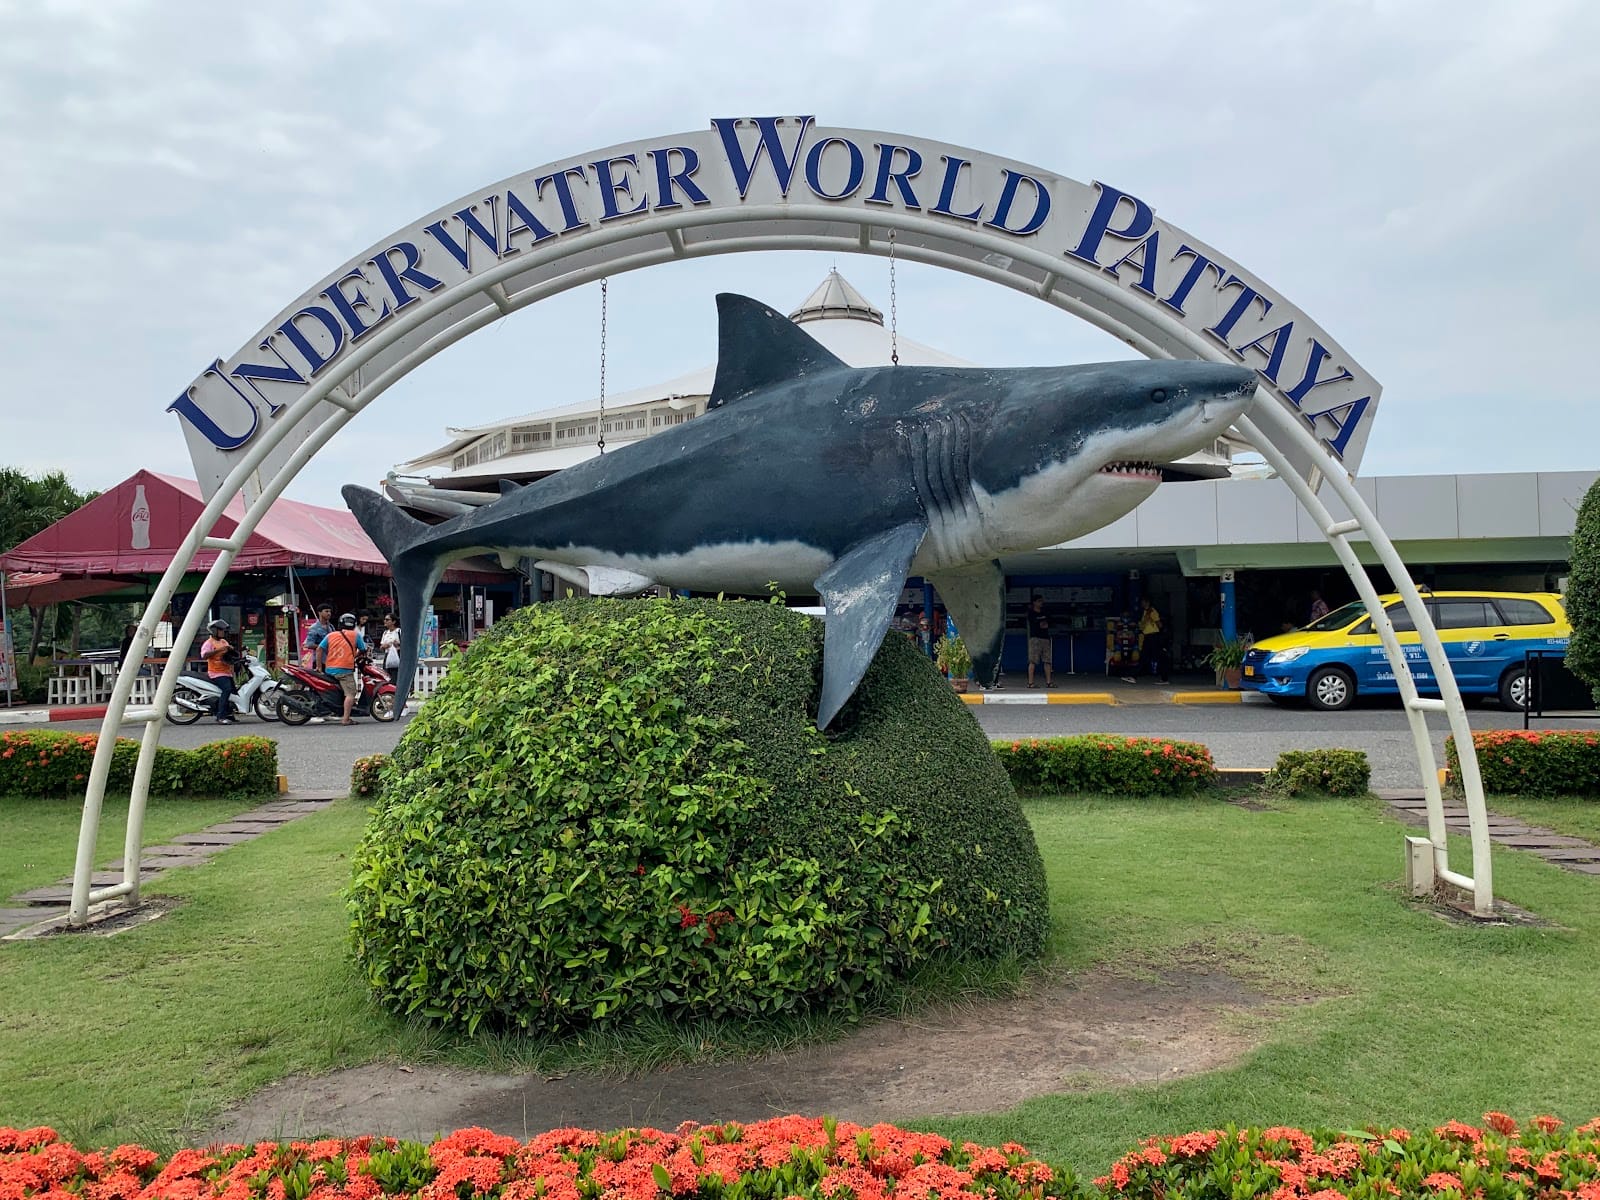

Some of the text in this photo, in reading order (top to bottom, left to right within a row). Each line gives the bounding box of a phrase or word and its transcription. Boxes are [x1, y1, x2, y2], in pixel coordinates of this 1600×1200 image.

[168, 116, 1370, 459] UNDERWATER WORLD PATTAYA
